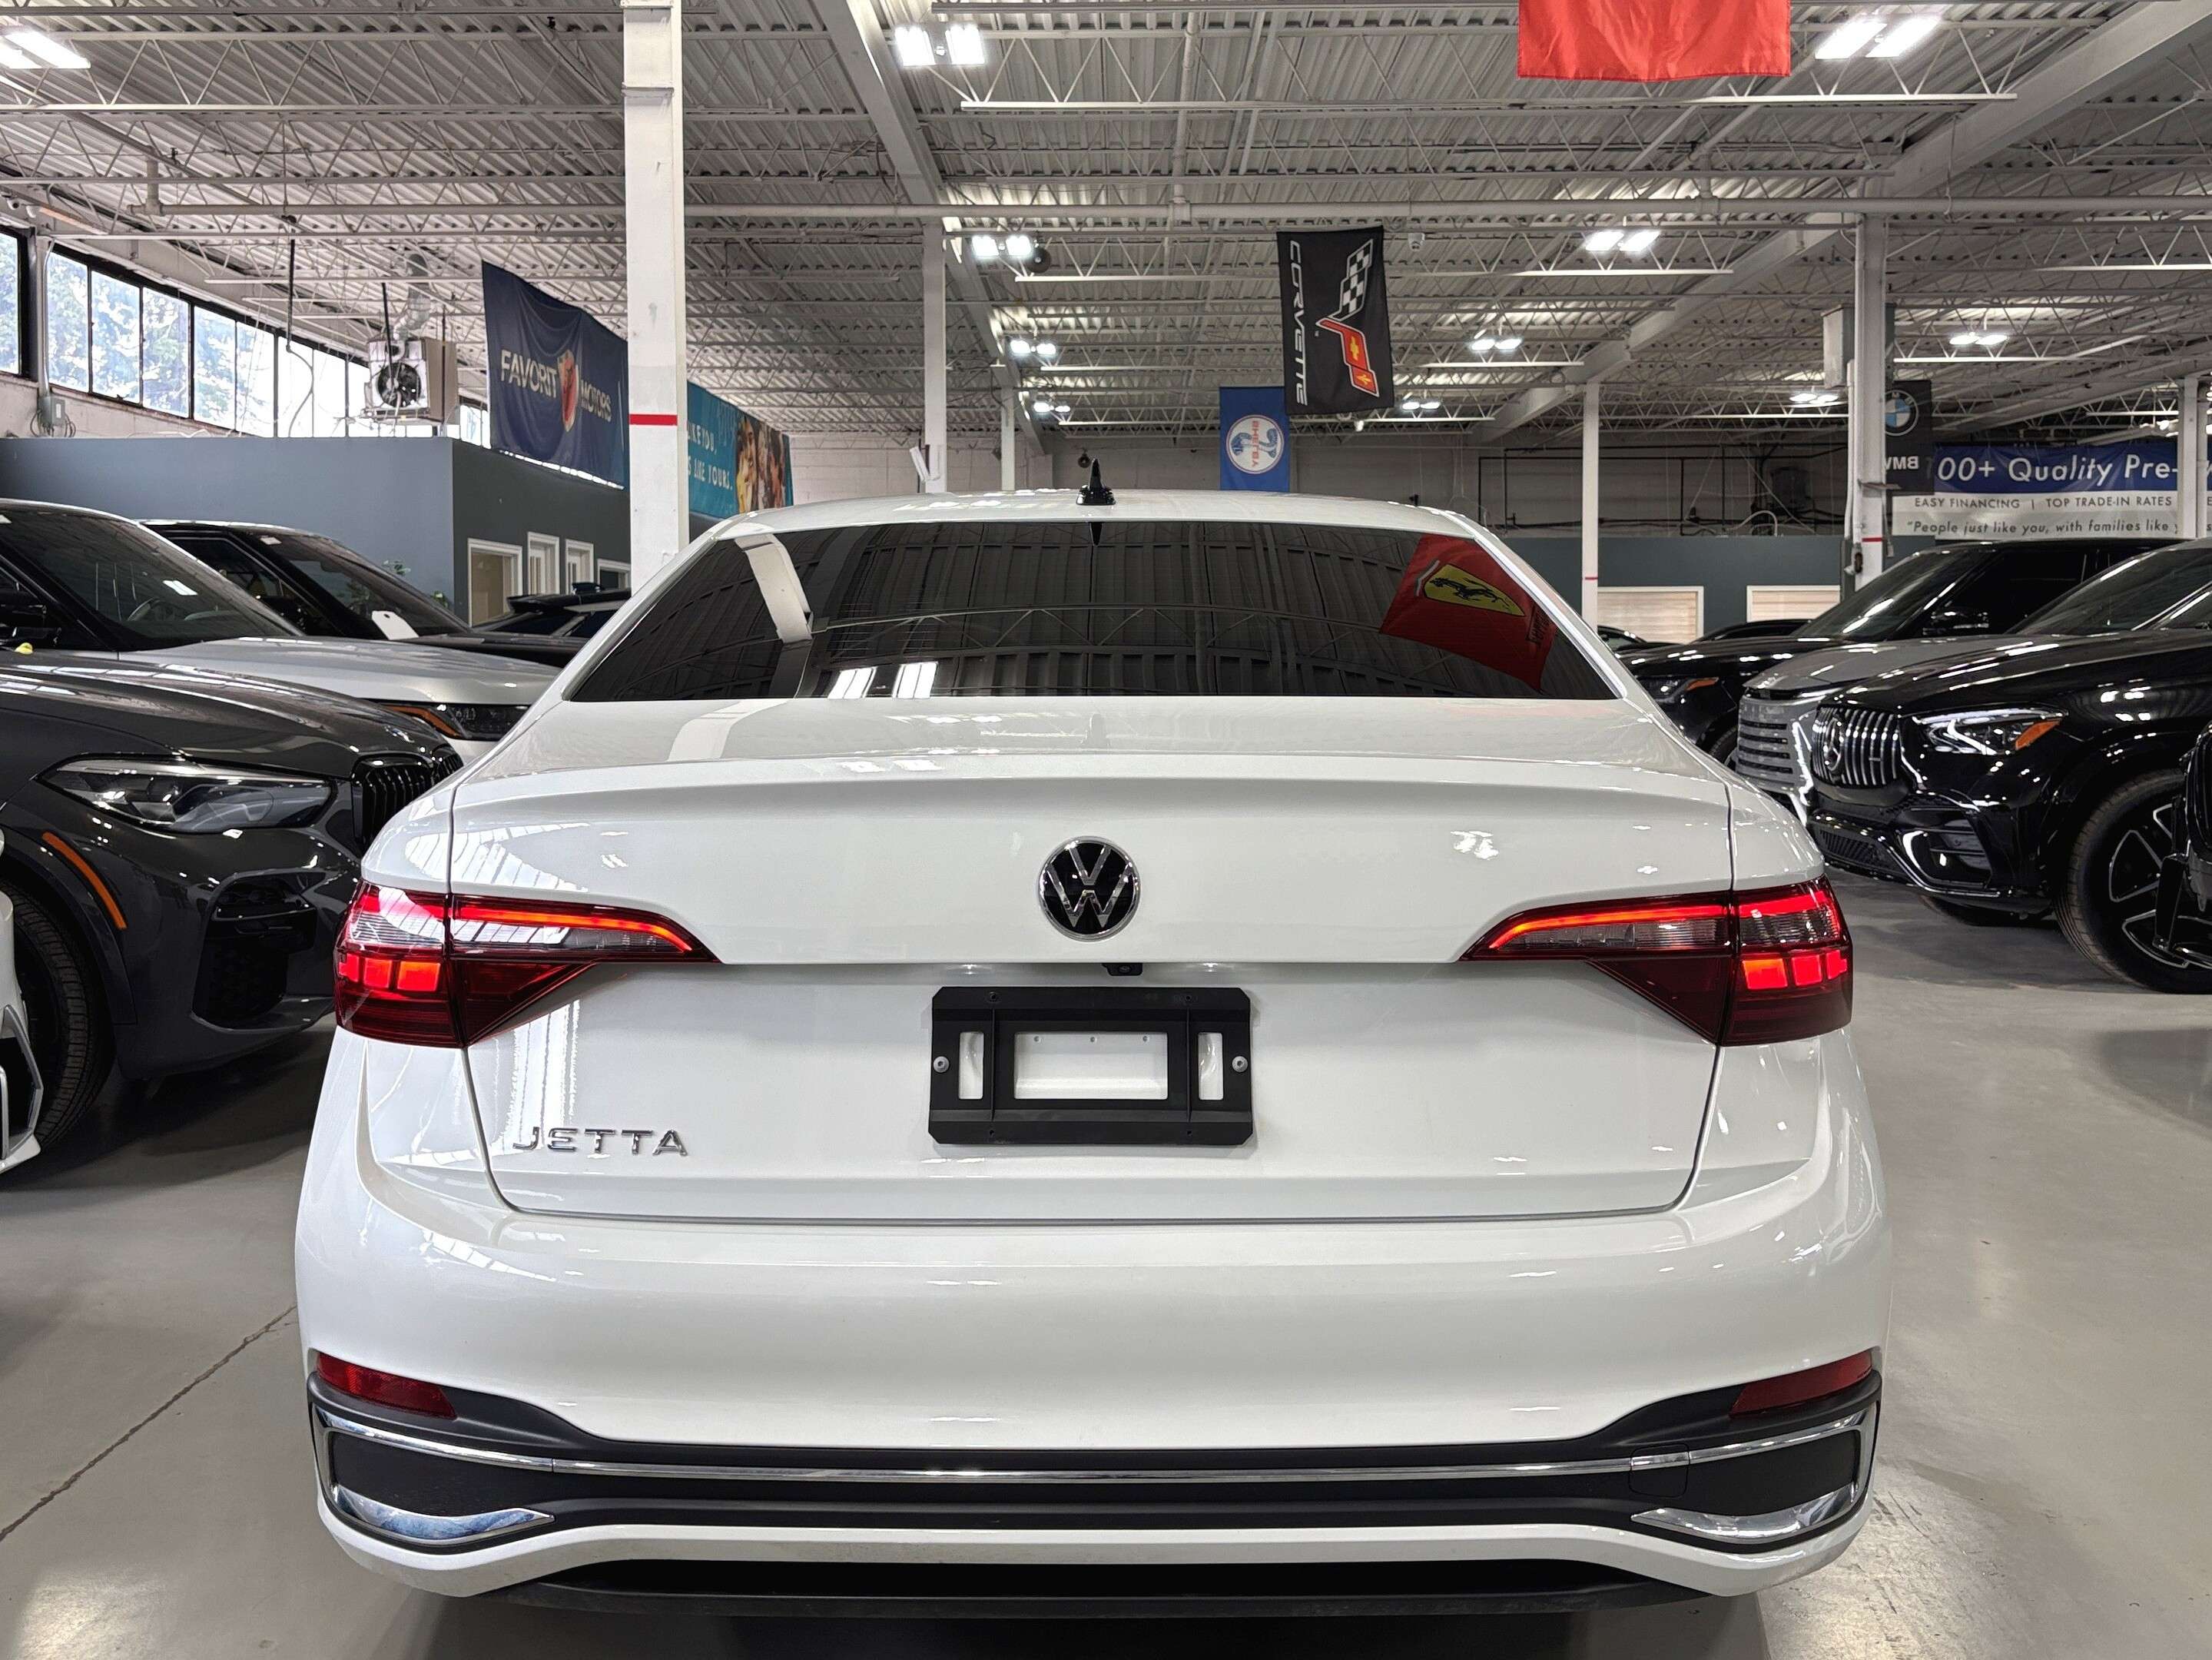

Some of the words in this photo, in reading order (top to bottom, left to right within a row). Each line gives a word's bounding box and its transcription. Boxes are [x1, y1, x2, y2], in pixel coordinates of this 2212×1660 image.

[1290, 240, 1308, 406] CORVETTE
[501, 349, 558, 399] FAVORIT
[580, 380, 612, 423] MOTORS
[2008, 454, 2114, 486] Quality
[1915, 497, 1945, 508] EASY
[1950, 498, 2021, 509] FINANCING
[2046, 497, 2071, 508] TOP
[2075, 496, 2131, 507] TRADE-IN
[2136, 496, 2172, 506] RATES
[1964, 522, 1988, 535] just
[1993, 521, 2018, 533] like
[2022, 523, 2049, 536] you,
[2056, 520, 2083, 533] with
[2088, 519, 2141, 532] families
[2146, 519, 2169, 531] like
[512, 1127, 689, 1157] JETTA
